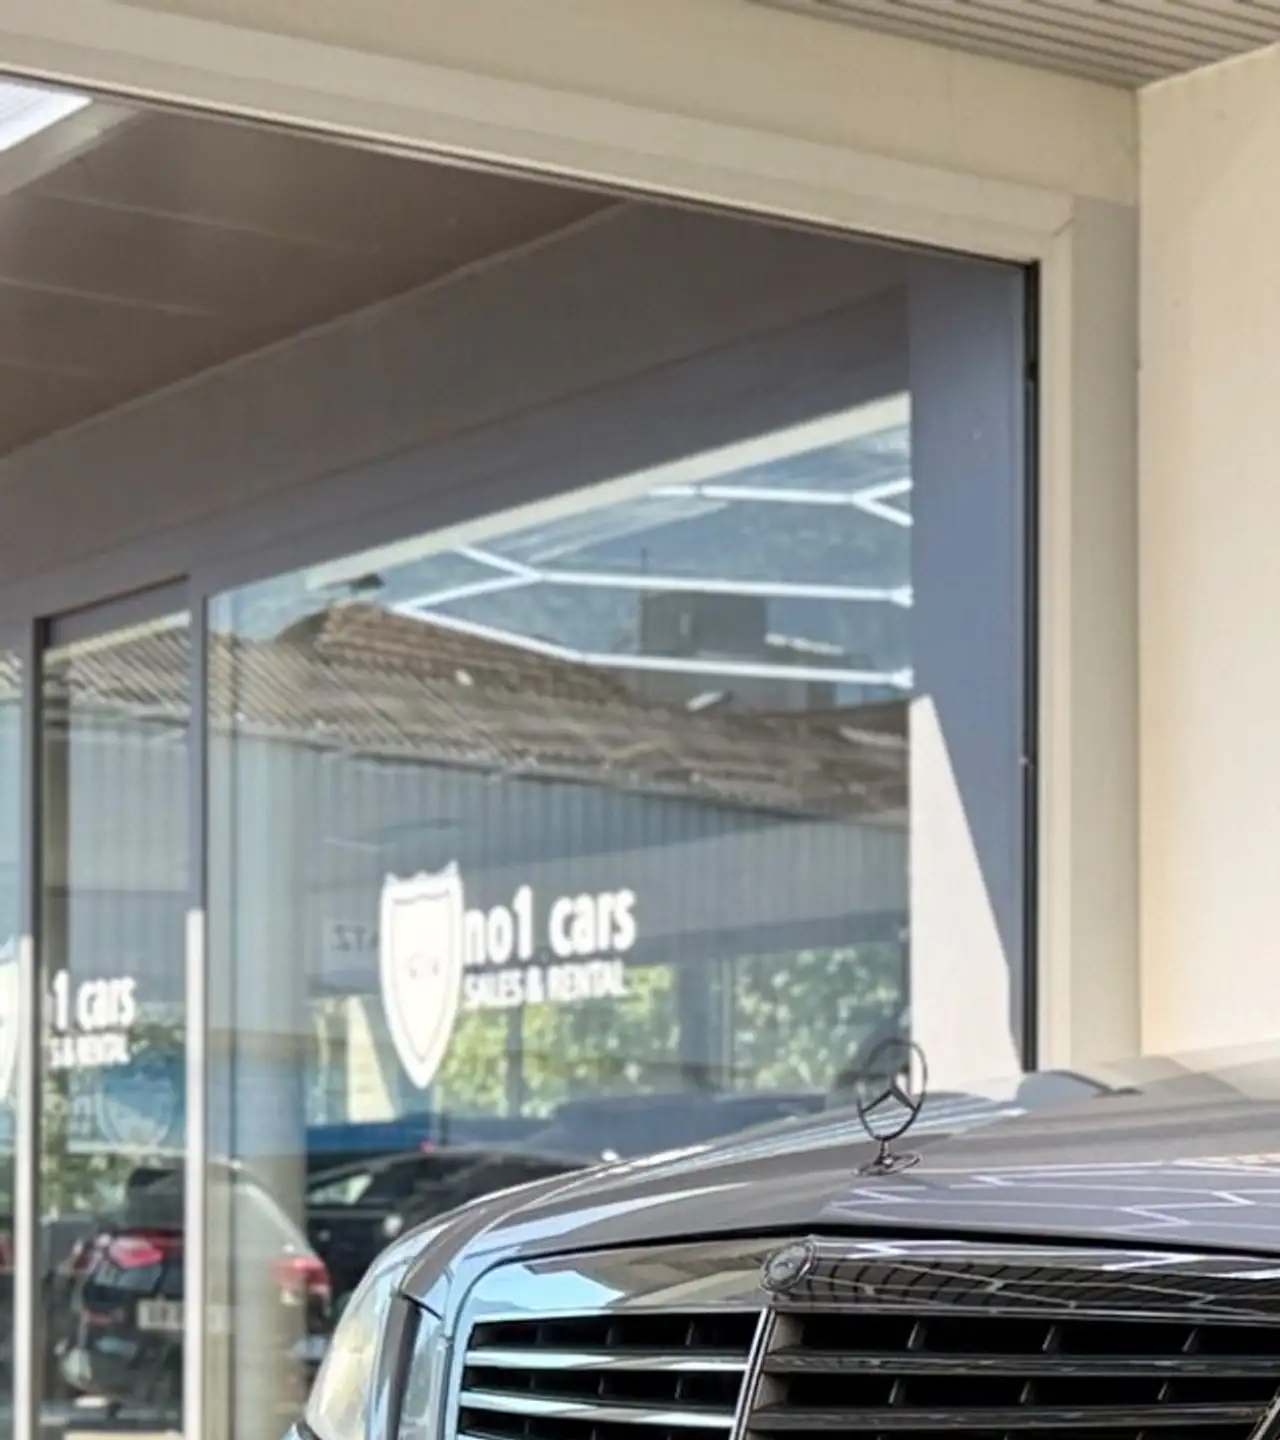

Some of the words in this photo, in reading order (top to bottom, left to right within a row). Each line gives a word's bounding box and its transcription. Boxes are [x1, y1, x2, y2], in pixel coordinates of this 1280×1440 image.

[463, 884, 533, 965] no1
[548, 887, 637, 957] cars
[77, 975, 137, 1031] cars
